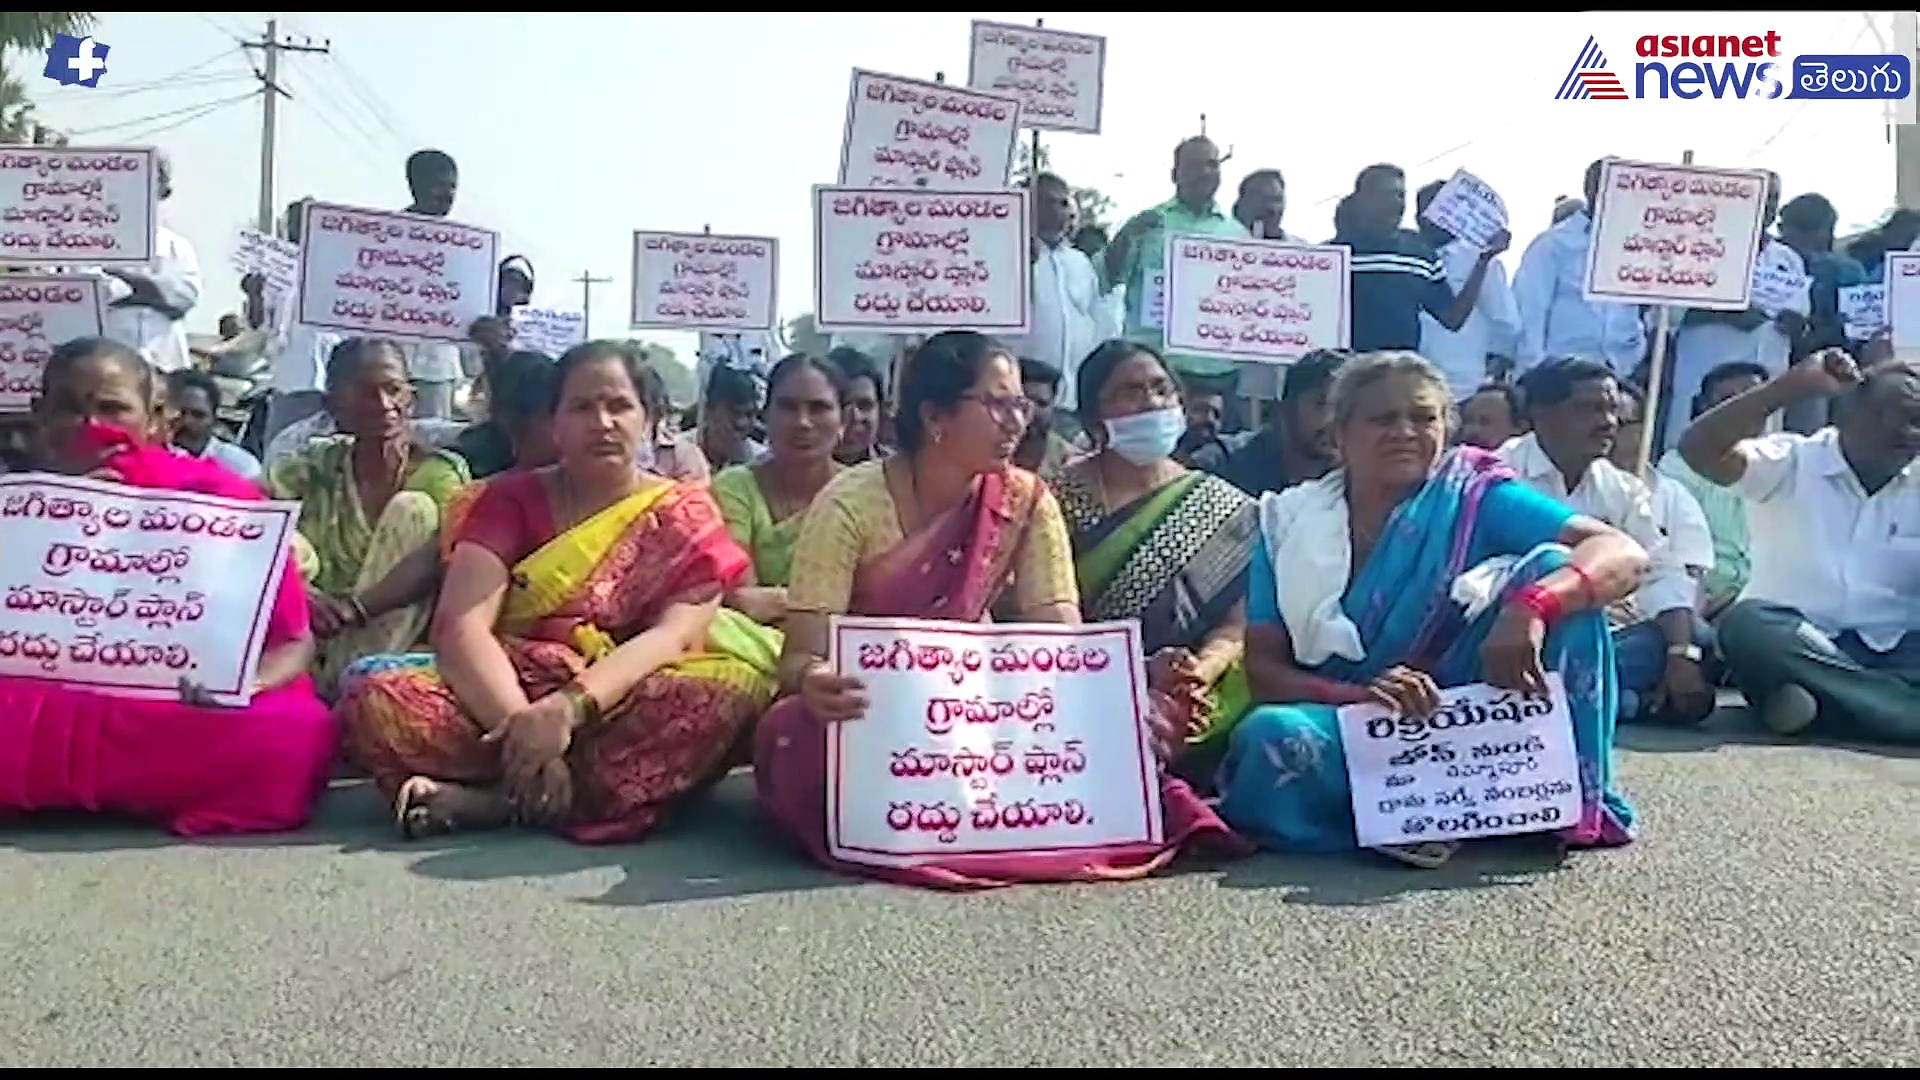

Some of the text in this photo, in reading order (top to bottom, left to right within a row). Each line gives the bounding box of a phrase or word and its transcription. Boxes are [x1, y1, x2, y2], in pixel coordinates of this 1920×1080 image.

[833, 195, 1010, 225] జగిత్యాల మండల
[876, 227, 970, 256] గ్రామాల్లో
[943, 259, 990, 288] ప్లాన్
[853, 292, 900, 319] రద్దు
[3, 490, 265, 540] జగిత్యాల మండల
[42, 542, 191, 585] గ్రామాల్లో
[135, 591, 207, 630] ప్లాన్
[858, 638, 1111, 685] జగిత్యాల మండల
[926, 687, 1056, 735] గ్రామాల్లో
[1023, 739, 1088, 786] ప్లాన్
[886, 799, 963, 845] రద్దు
